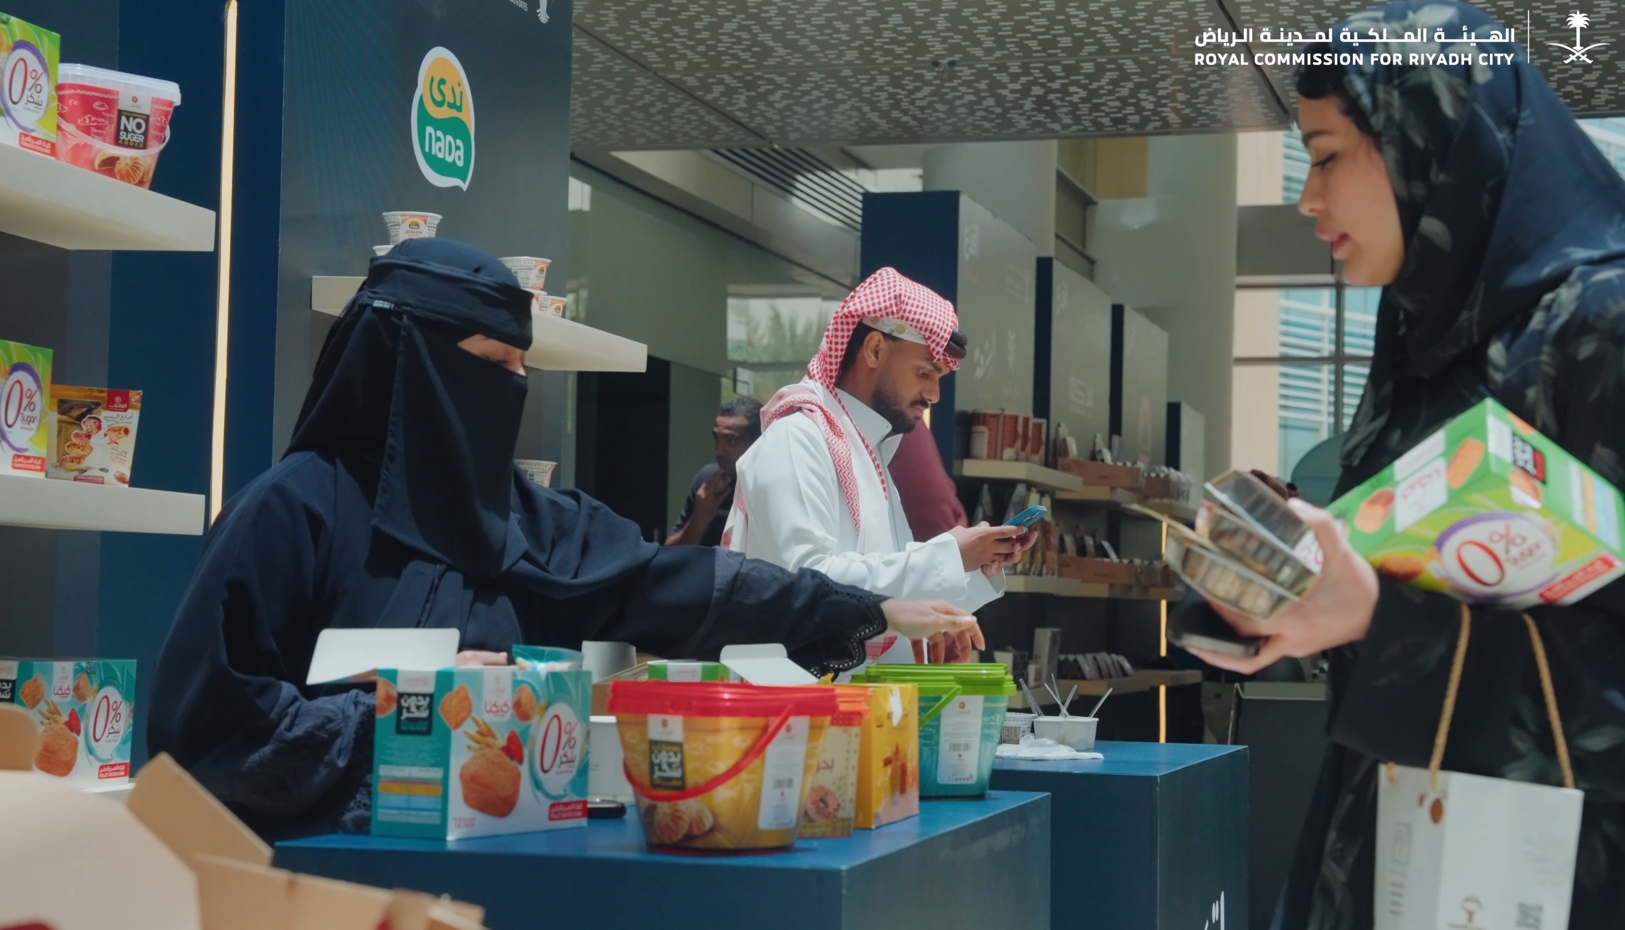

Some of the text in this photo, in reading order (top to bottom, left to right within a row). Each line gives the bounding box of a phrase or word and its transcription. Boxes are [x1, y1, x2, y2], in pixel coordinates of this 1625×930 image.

[8, 57, 44, 105] 0%
[118, 140, 144, 148] ADDED
[119, 131, 144, 143] SUGER
[120, 115, 146, 134] NO
[4, 379, 38, 428] 0%
[1455, 523, 1527, 588] 0%
[92, 695, 123, 742] 0%
[540, 714, 578, 773] 0%
